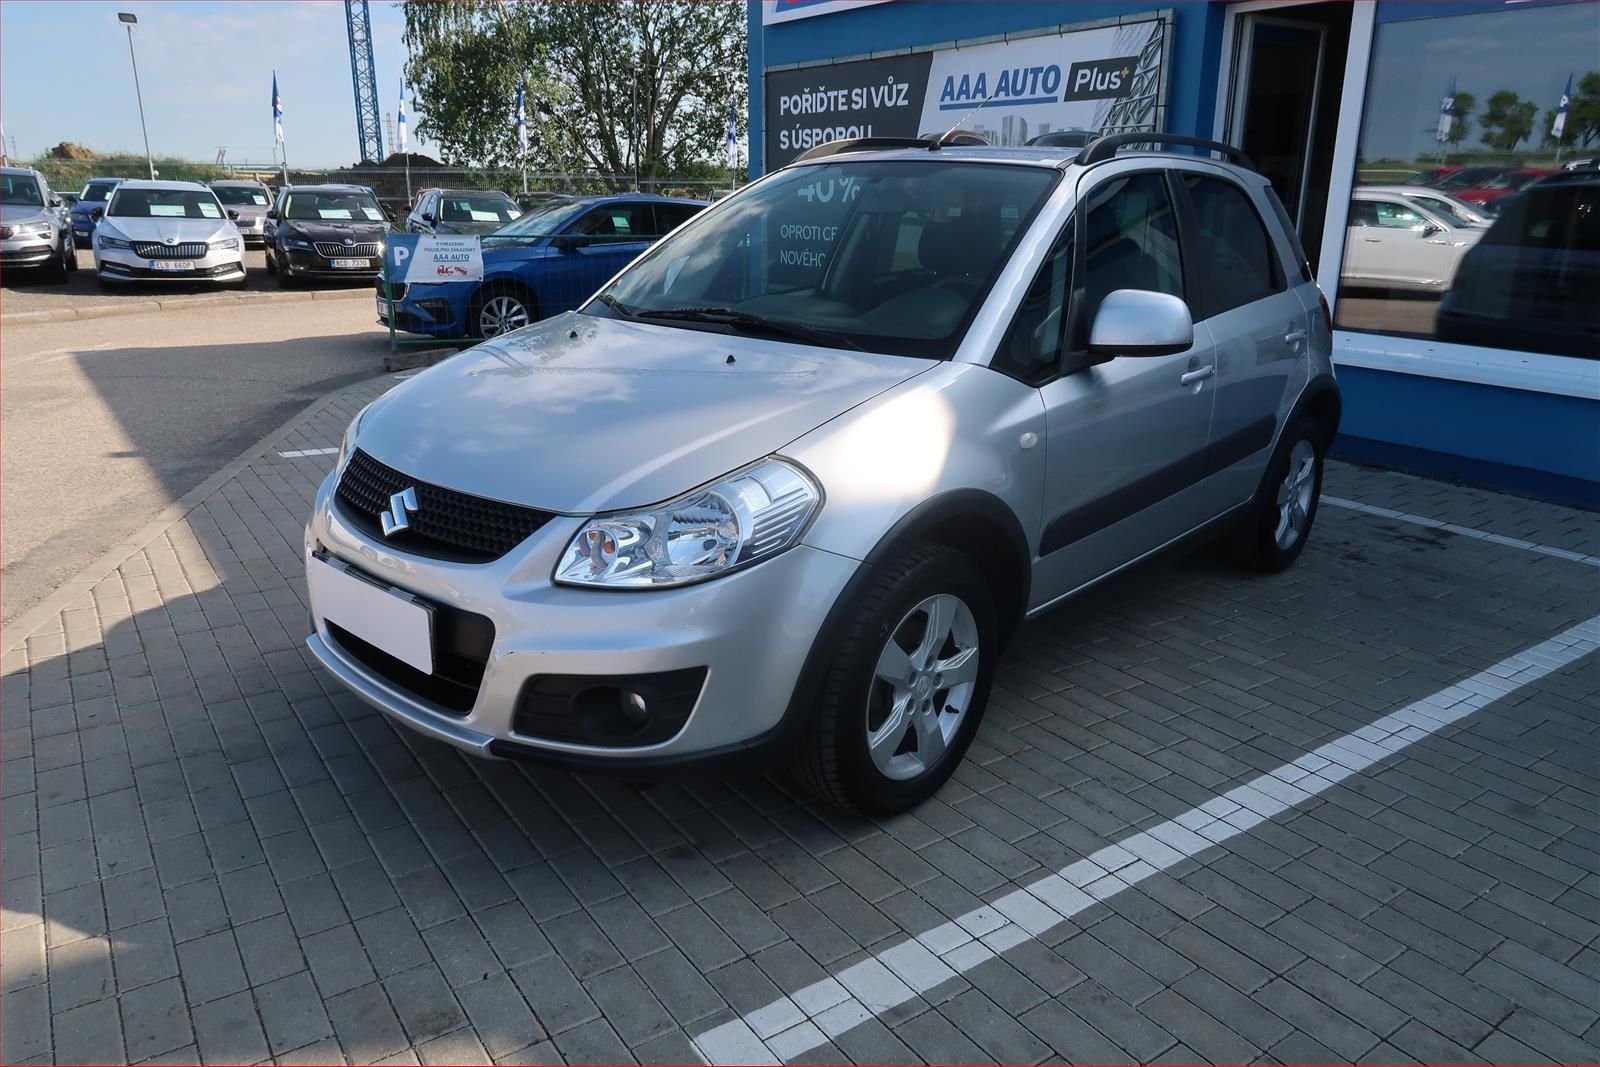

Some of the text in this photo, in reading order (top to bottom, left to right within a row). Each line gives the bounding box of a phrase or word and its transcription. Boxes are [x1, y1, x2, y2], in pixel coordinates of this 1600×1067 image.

[940, 72, 988, 102] AAA
[993, 64, 1062, 98] AUTO
[780, 75, 910, 116] POŘIĎTE SI VŮZ
[780, 129, 790, 150] S
[780, 224, 821, 241] OPROTI
[393, 246, 410, 266] P
